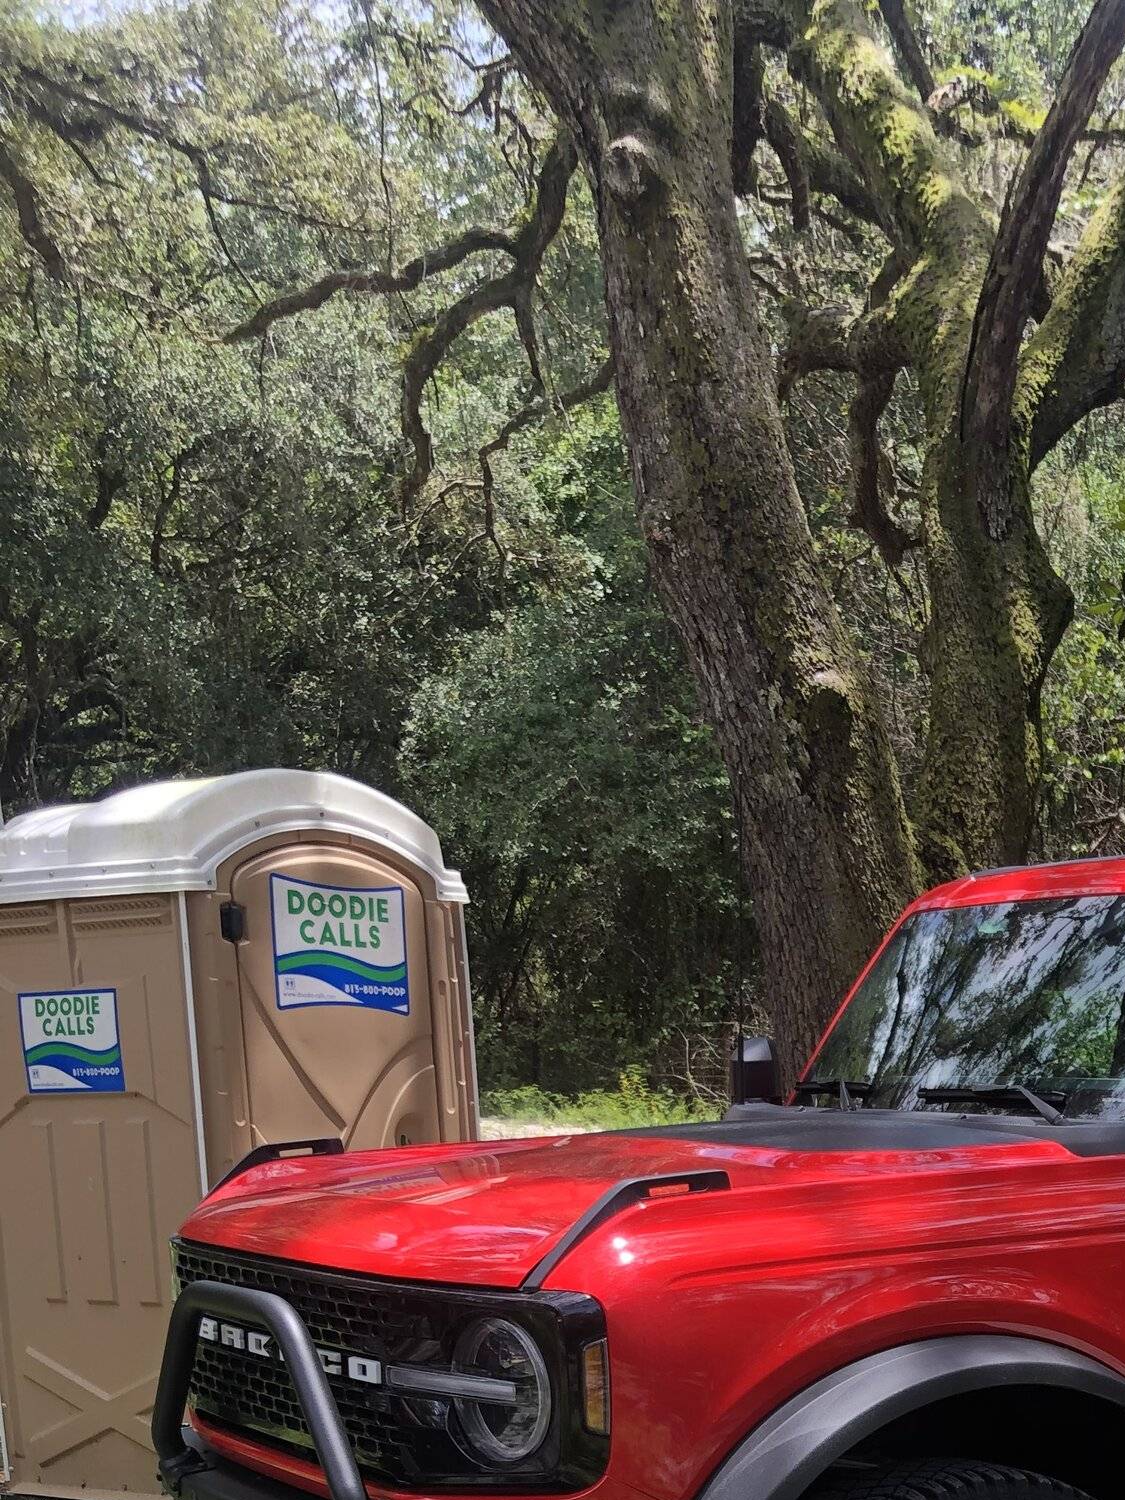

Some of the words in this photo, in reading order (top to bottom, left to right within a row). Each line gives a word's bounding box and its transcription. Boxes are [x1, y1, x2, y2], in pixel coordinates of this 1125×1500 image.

[287, 889, 389, 923] DOODIE
[299, 919, 381, 949] CALLS
[34, 995, 100, 1017] DOODIE
[42, 1016, 95, 1036] CALLS
[198, 1316, 382, 1385] BROCO
